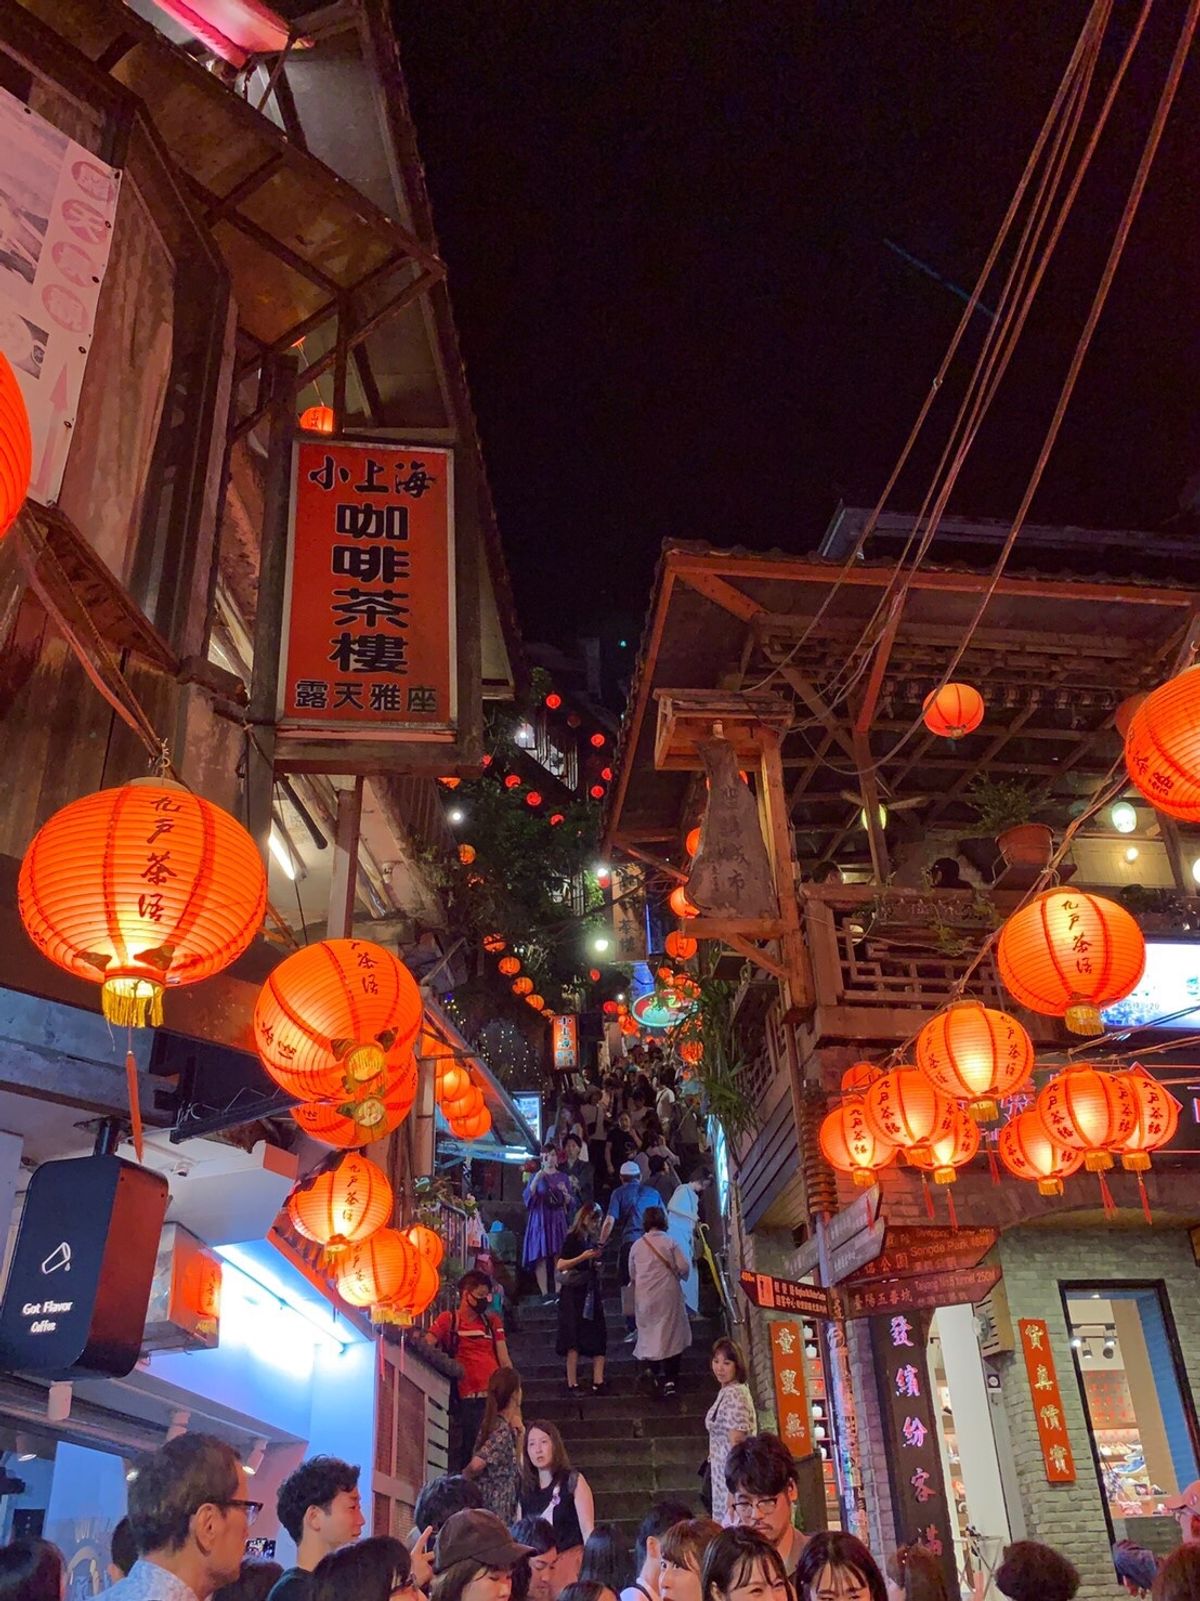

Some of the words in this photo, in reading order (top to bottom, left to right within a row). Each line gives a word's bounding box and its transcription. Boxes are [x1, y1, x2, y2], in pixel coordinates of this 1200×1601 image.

[308, 455, 437, 498] 小上海
[328, 503, 410, 675] 咖啡茶樓
[295, 680, 437, 713] 露天雅座
[22, 1303, 41, 1316] Got
[43, 1300, 73, 1314] Flavor
[30, 1319, 57, 1333] Coffee
